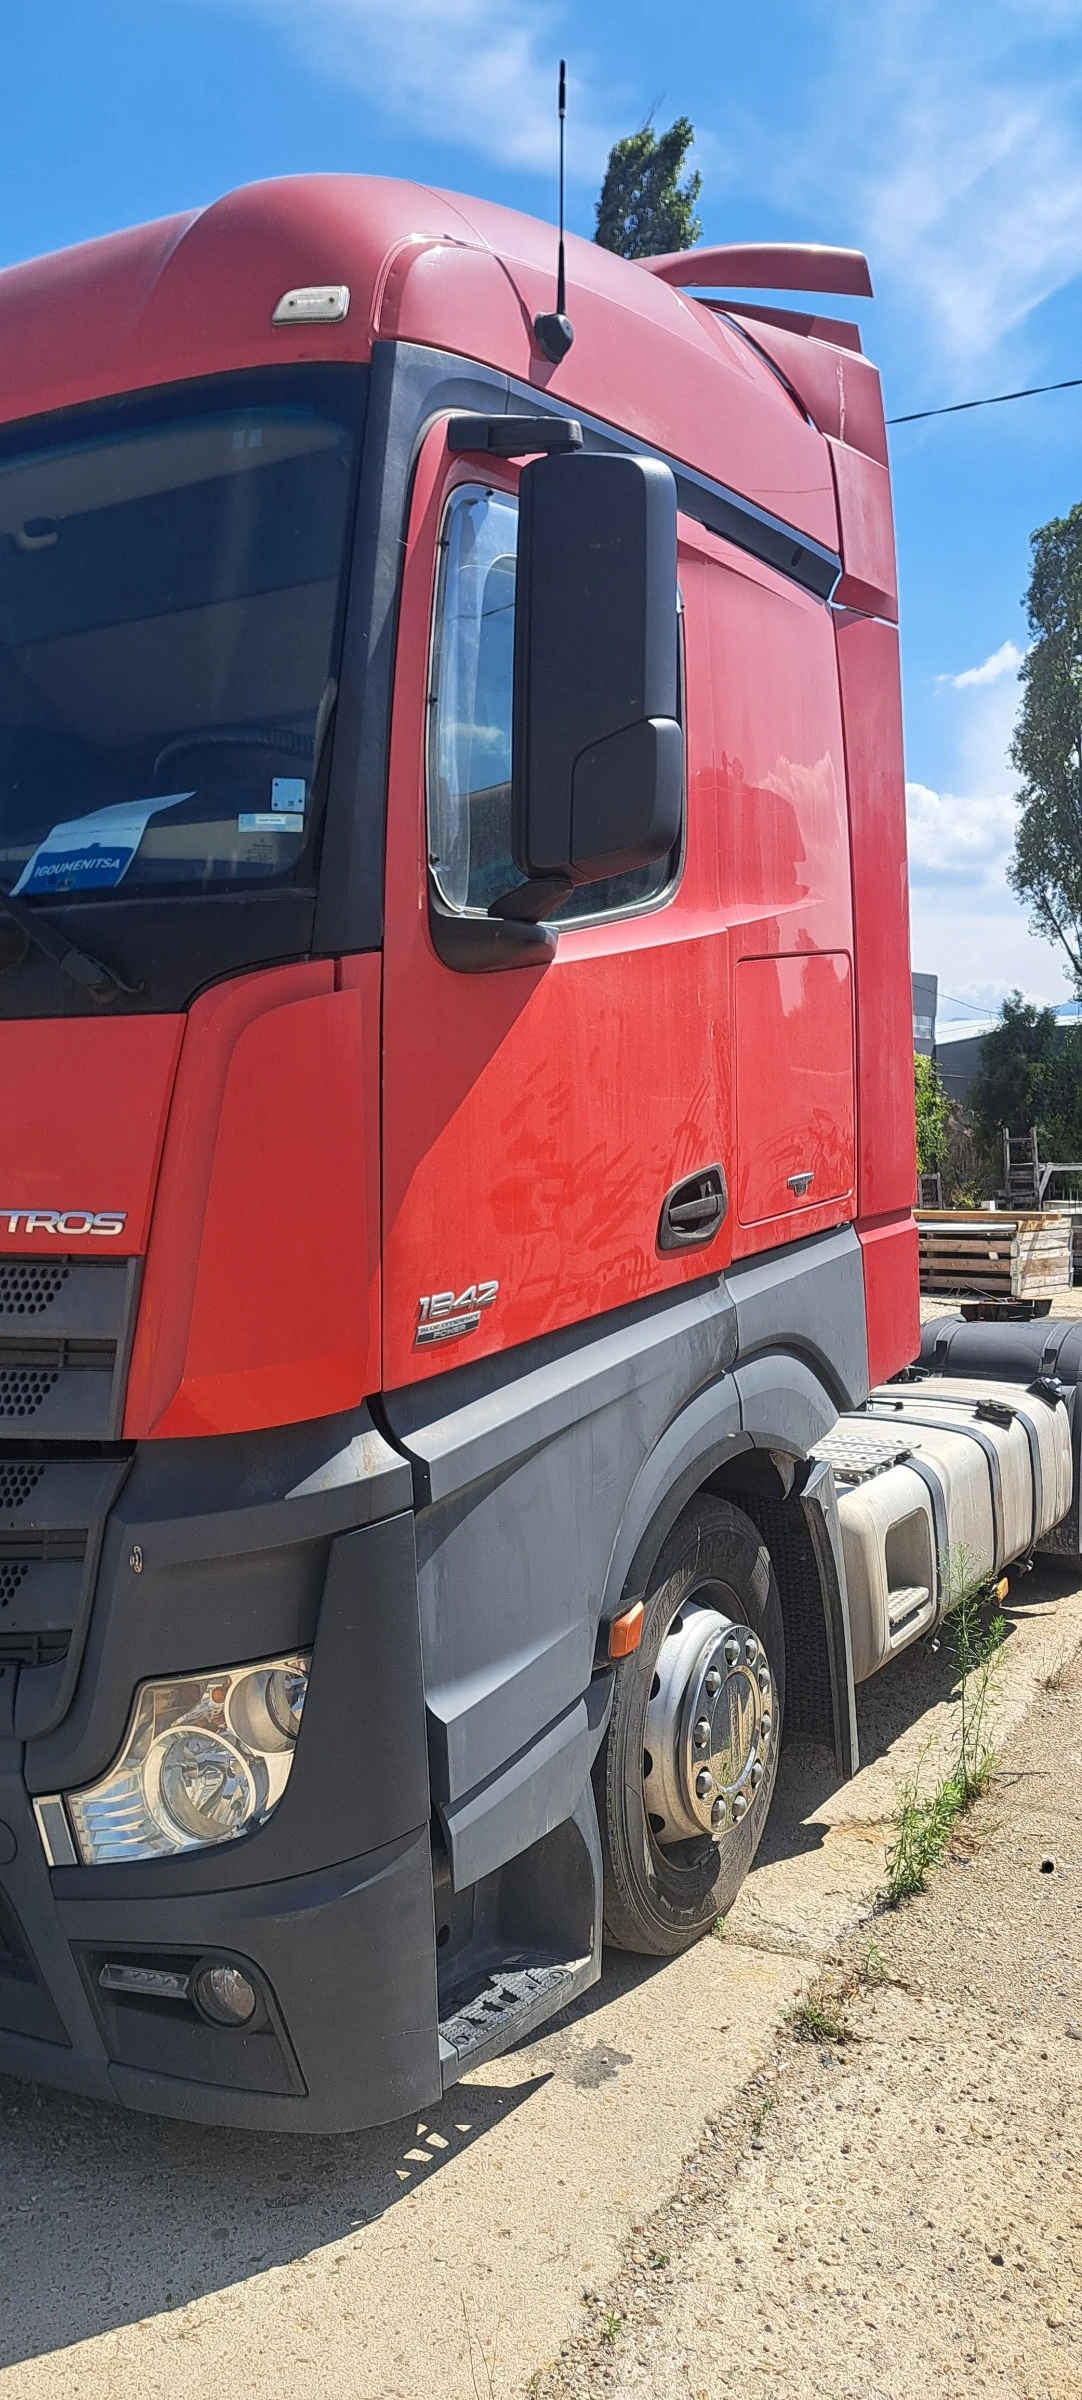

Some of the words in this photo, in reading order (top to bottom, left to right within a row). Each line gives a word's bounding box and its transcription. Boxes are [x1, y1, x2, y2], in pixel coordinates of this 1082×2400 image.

[34, 858, 120, 877] IGOUMENITSA
[419, 1280, 499, 1321] 1842
[432, 1323, 467, 1339] POWER
